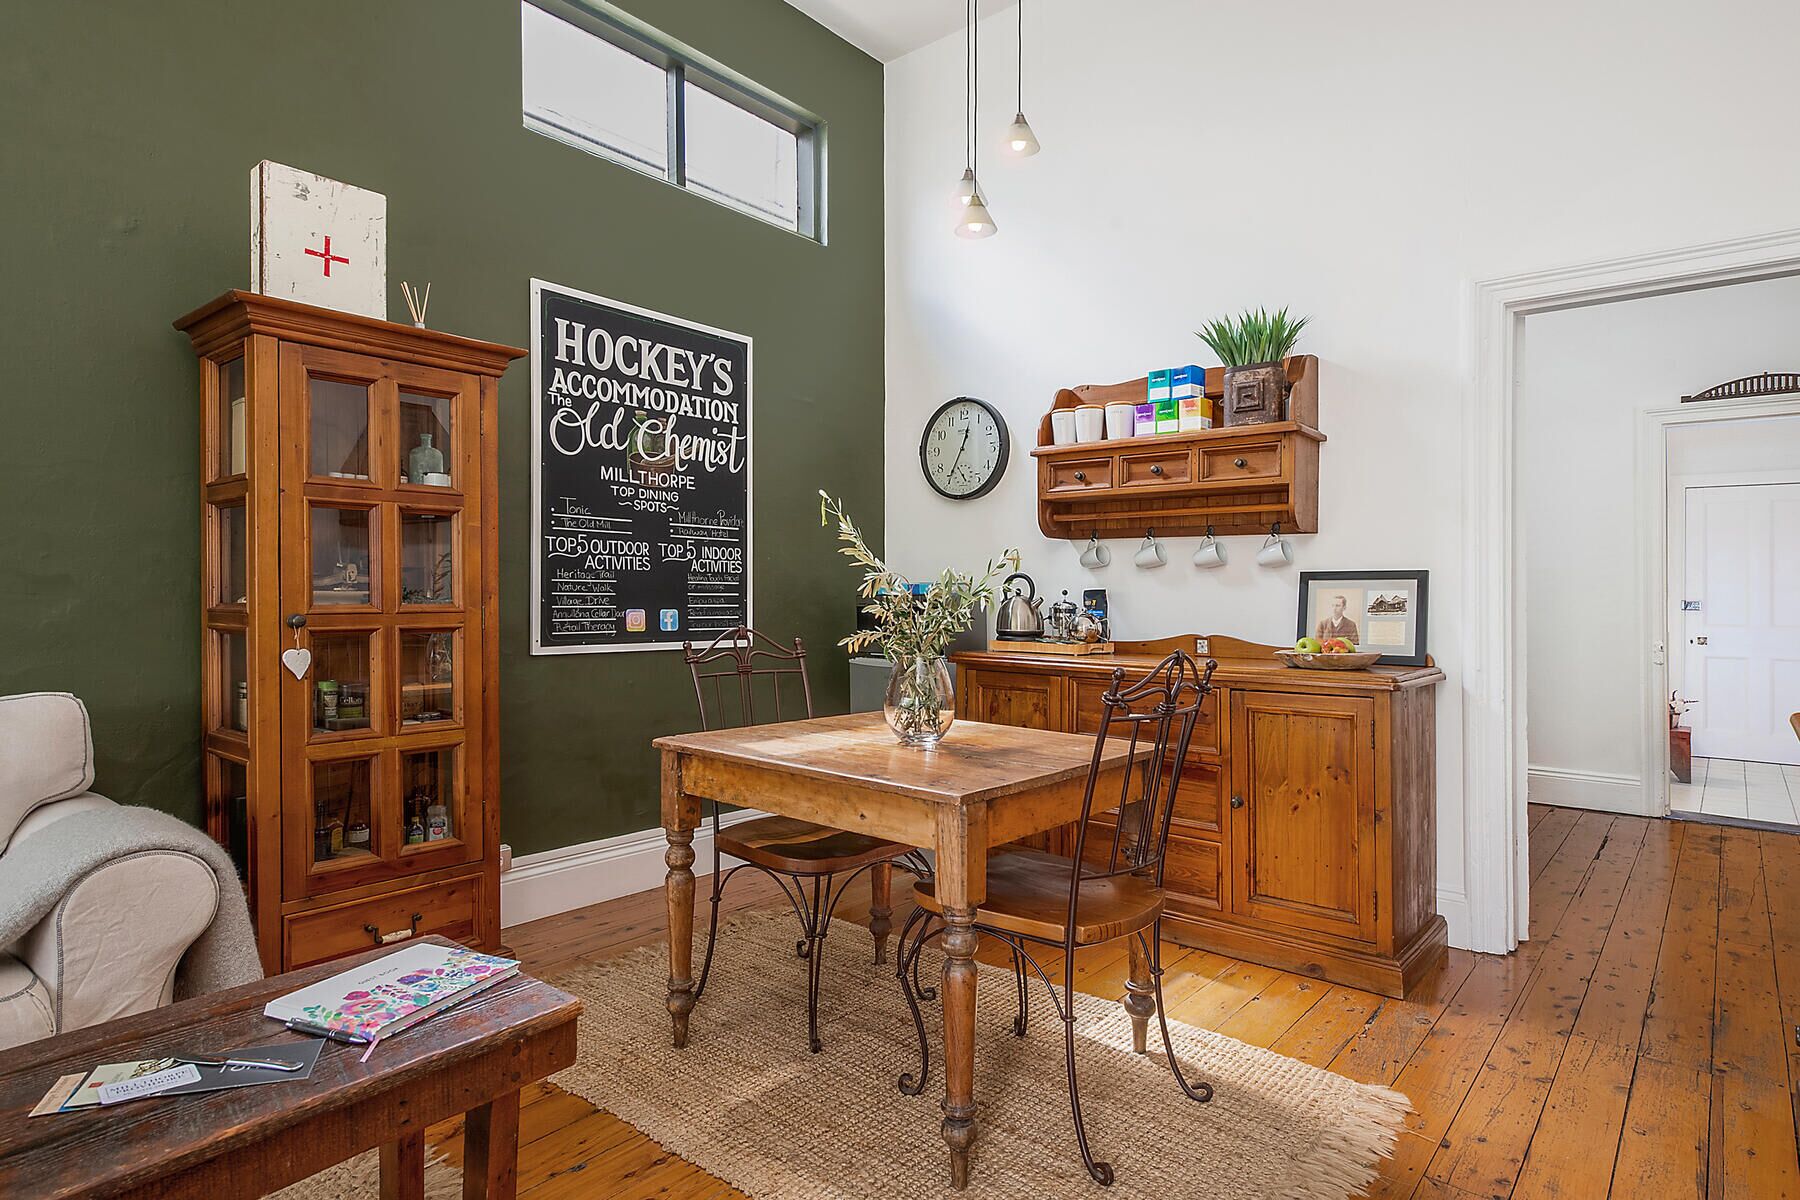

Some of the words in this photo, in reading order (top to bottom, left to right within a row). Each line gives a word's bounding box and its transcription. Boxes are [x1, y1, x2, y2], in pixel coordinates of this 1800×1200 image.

[554, 317, 734, 396] HOCKEY'S
[547, 390, 572, 407] The
[548, 367, 739, 424] ACCOMMODATION
[960, 409, 969, 420] 12
[948, 416, 954, 427] 11
[937, 430, 947, 440] 10
[985, 425, 993, 436] 2
[549, 401, 631, 456] Old
[632, 413, 746, 473] Chemist
[933, 447, 941, 457] 9
[989, 441, 997, 453] 3
[937, 463, 944, 473] 8
[983, 459, 991, 470] 4
[600, 465, 696, 490] MILLTHORPE
[975, 472, 982, 483] 5
[610, 485, 636, 497] TOP
[638, 488, 679, 502] DINING
[560, 496, 591, 515] Tonic
[561, 517, 577, 528] The
[579, 518, 594, 528] Old
[596, 520, 611, 529] Mill
[678, 527, 708, 541] Railway
[711, 529, 729, 538] Hotel
[544, 535, 577, 553] TOP
[576, 534, 589, 554] 5
[590, 539, 650, 557] OUTDOOR
[658, 543, 684, 558] TOP
[686, 540, 697, 559] 5
[701, 546, 742, 560] INDOOR
[584, 554, 651, 571] ACTIVITIES
[690, 559, 743, 574] ACTIVITIES
[596, 569, 615, 579] Trail
[557, 582, 588, 592] Nature
[591, 583, 614, 592] Walk
[585, 595, 610, 605] Drive
[591, 608, 610, 618] Cellar
[611, 608, 625, 618] Door
[553, 621, 580, 632] Retail
[581, 621, 616, 636] Therapy
